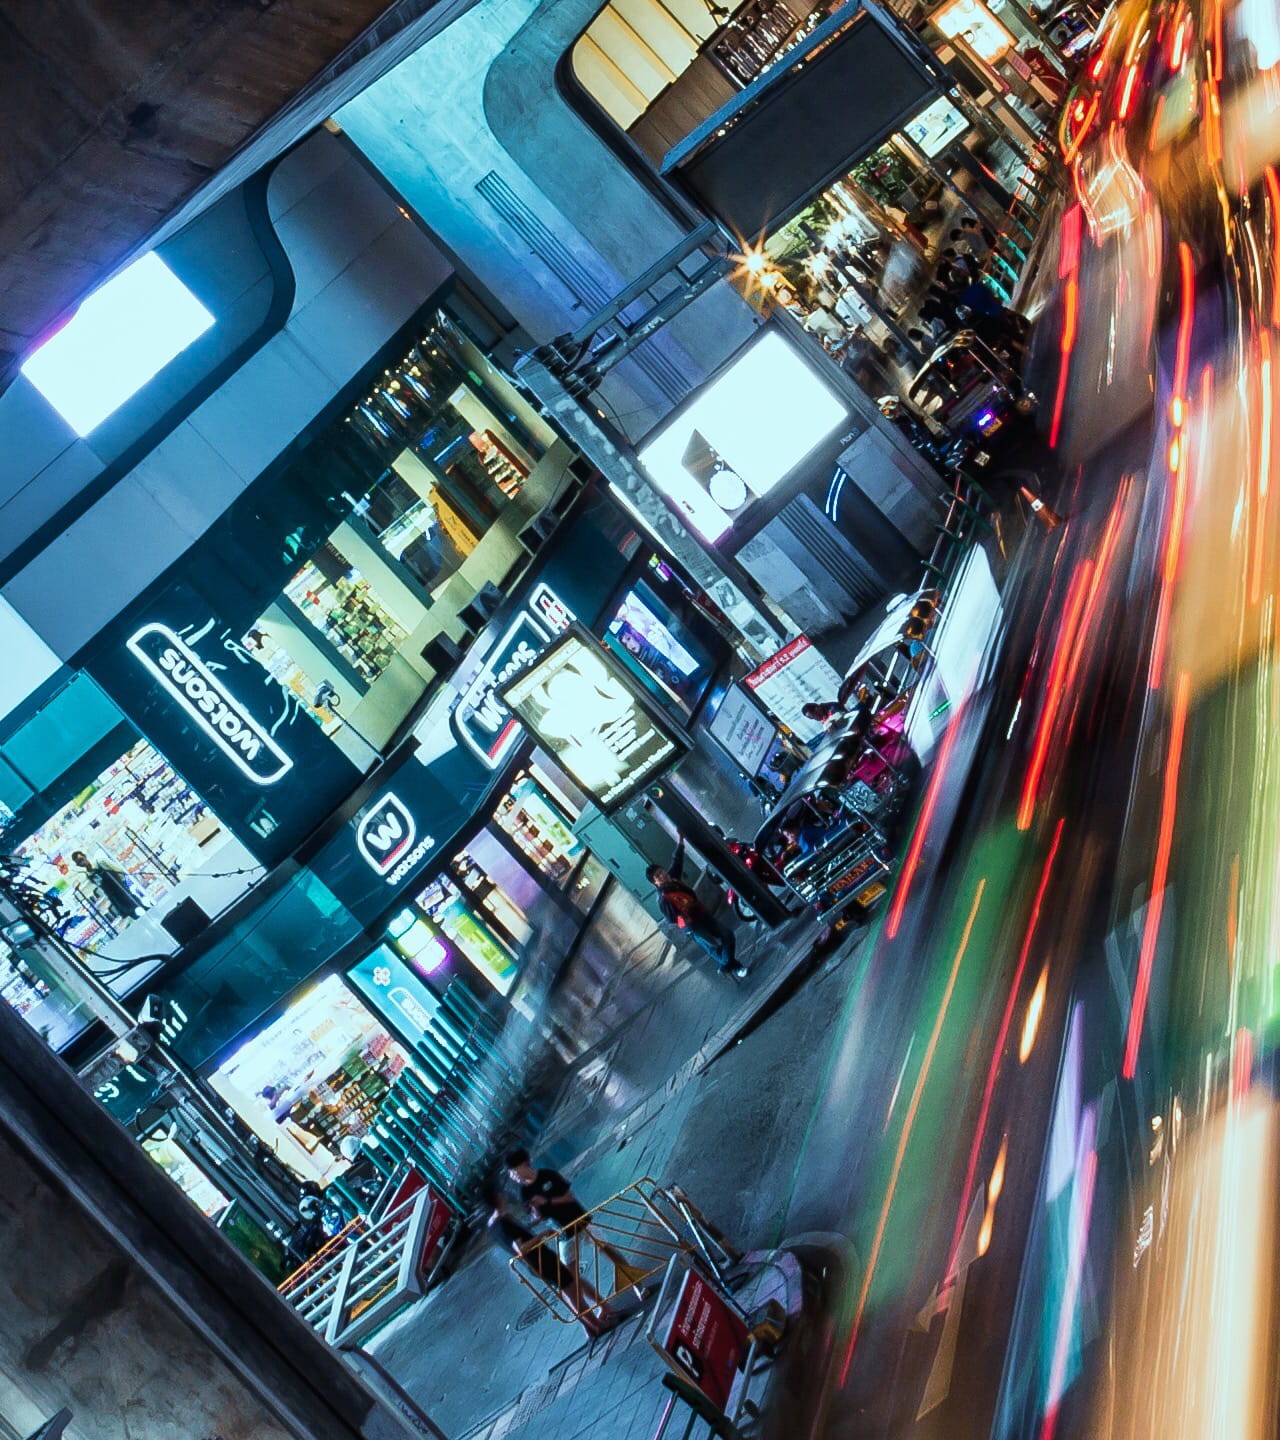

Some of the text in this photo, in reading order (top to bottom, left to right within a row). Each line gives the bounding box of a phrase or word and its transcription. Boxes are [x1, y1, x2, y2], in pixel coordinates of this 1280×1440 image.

[157, 646, 261, 761] watsons
[364, 812, 404, 851] W
[385, 833, 437, 886] watsons
